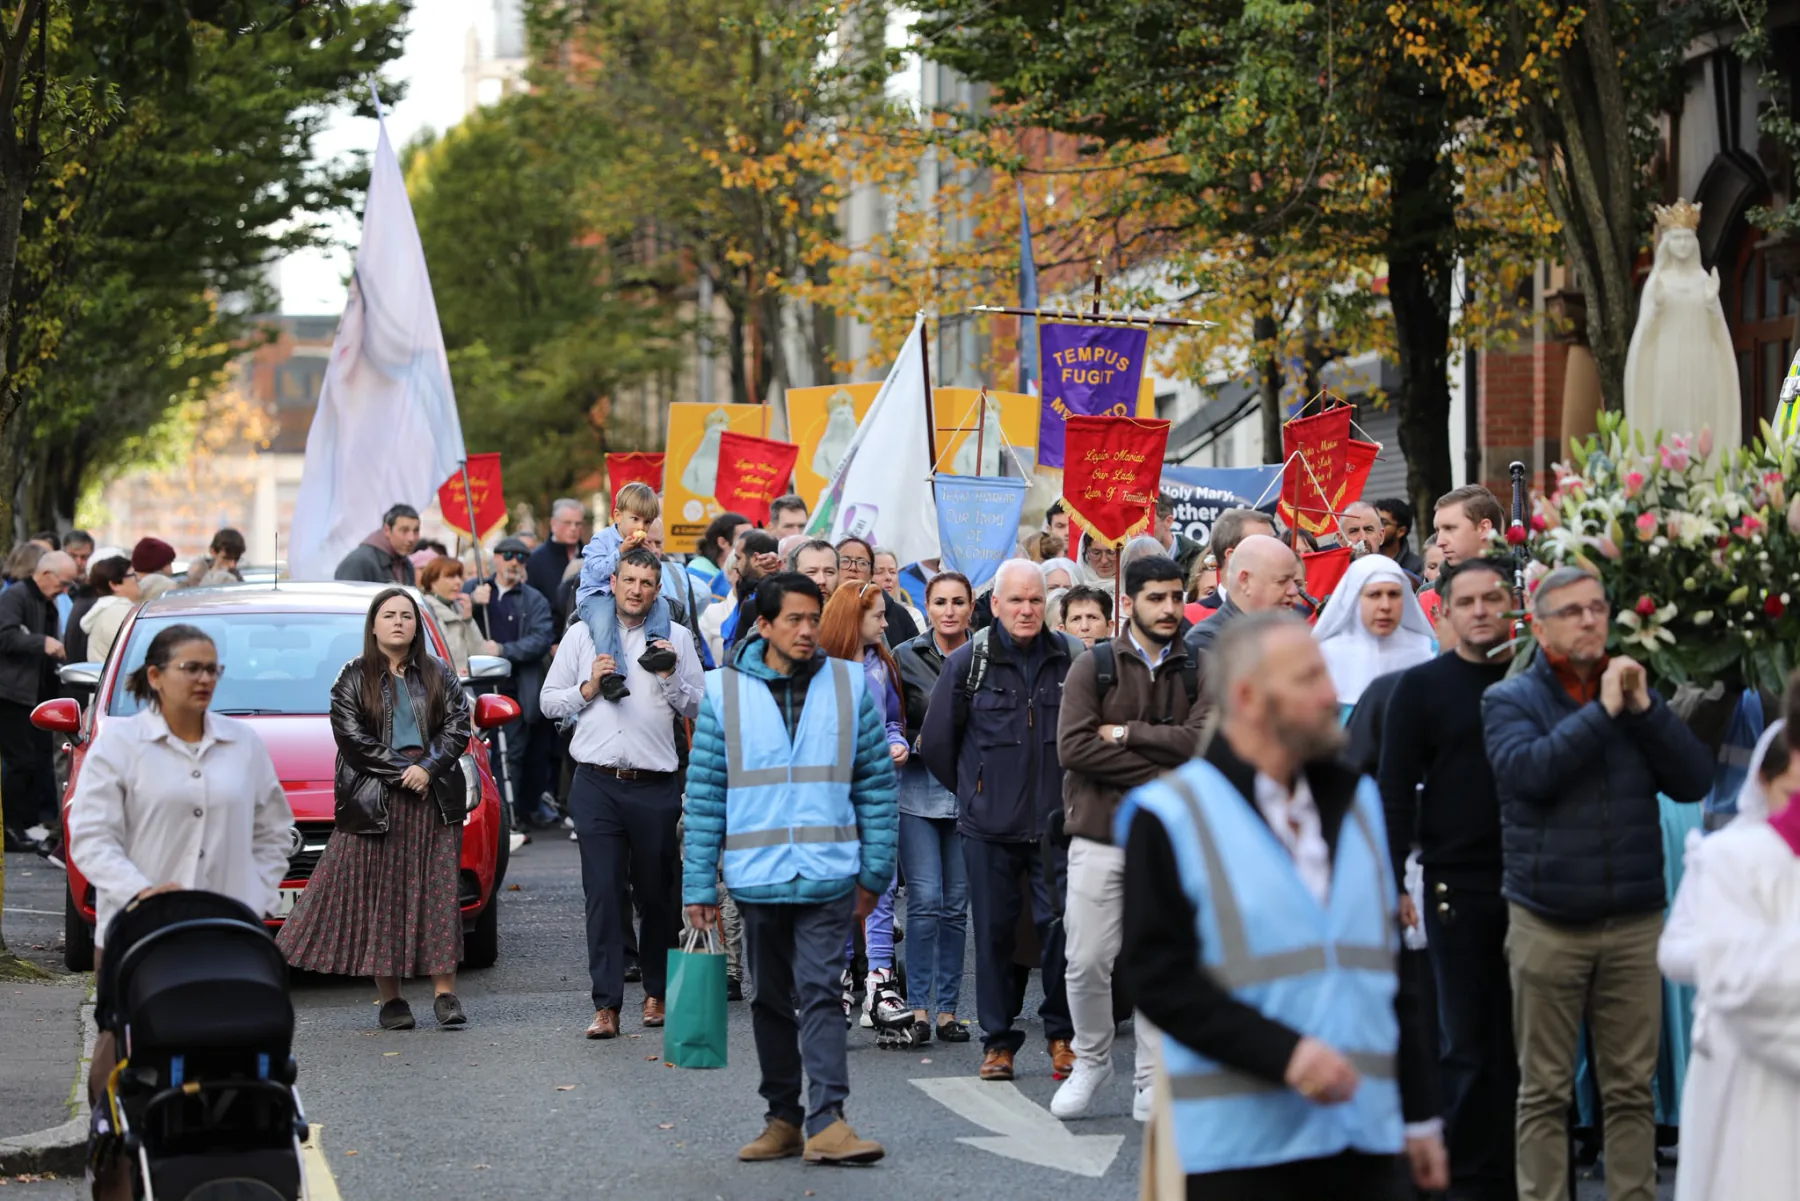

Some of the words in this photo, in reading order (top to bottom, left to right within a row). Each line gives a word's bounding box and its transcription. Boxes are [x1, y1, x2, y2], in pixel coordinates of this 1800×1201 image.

[1053, 347, 1130, 372] TEMPUS
[1062, 368, 1115, 384] FUGIT
[1084, 448, 1109, 464] Legio
[1113, 449, 1146, 463] Mariae
[1092, 467, 1109, 480] Our
[1112, 468, 1136, 484] Lady
[1122, 490, 1148, 503] Families
[1196, 486, 1236, 502] Mary,
